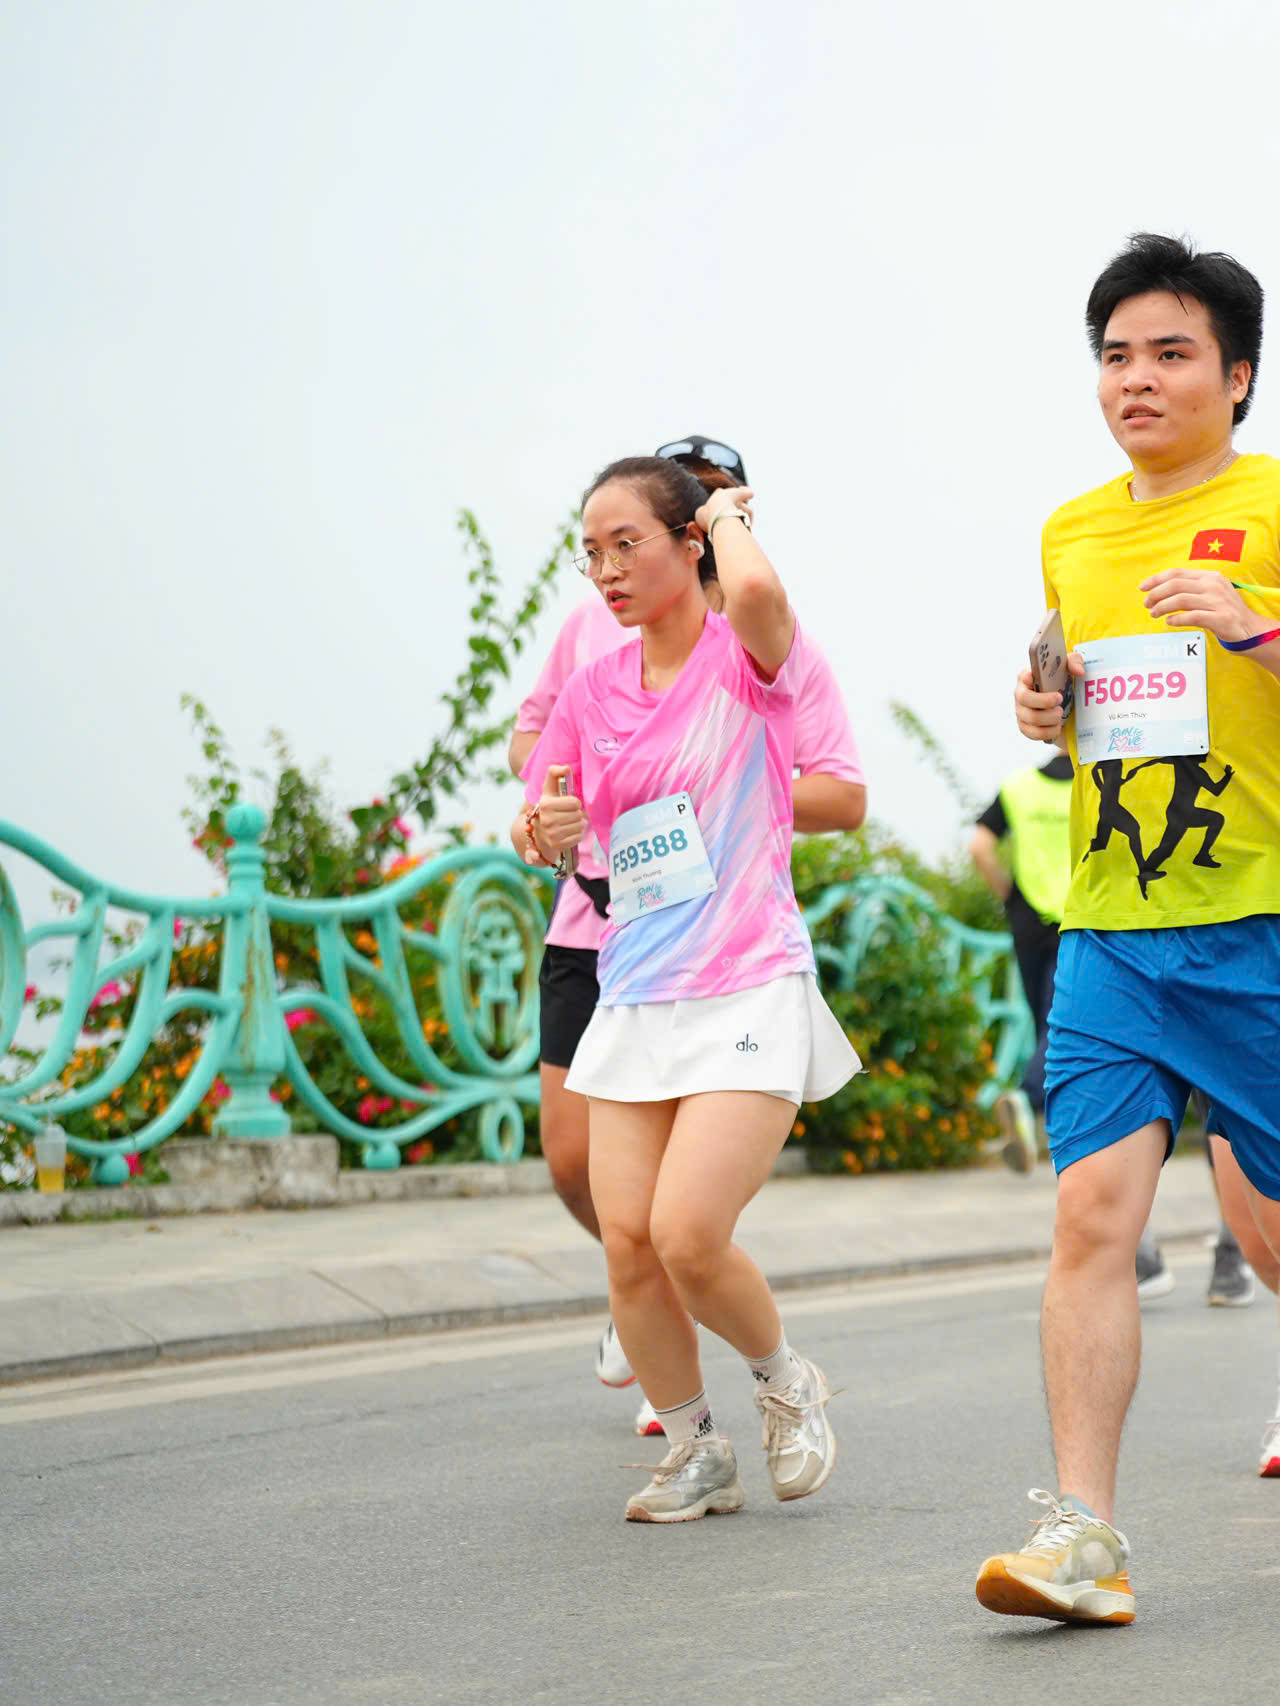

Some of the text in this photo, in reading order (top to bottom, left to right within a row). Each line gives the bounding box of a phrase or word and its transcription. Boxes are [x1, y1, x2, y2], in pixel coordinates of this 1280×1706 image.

[1186, 643, 1198, 657] K
[1084, 671, 1187, 707] F50259
[677, 803, 686, 815] P
[612, 828, 689, 877] F59388
[735, 1033, 759, 1052] alo
